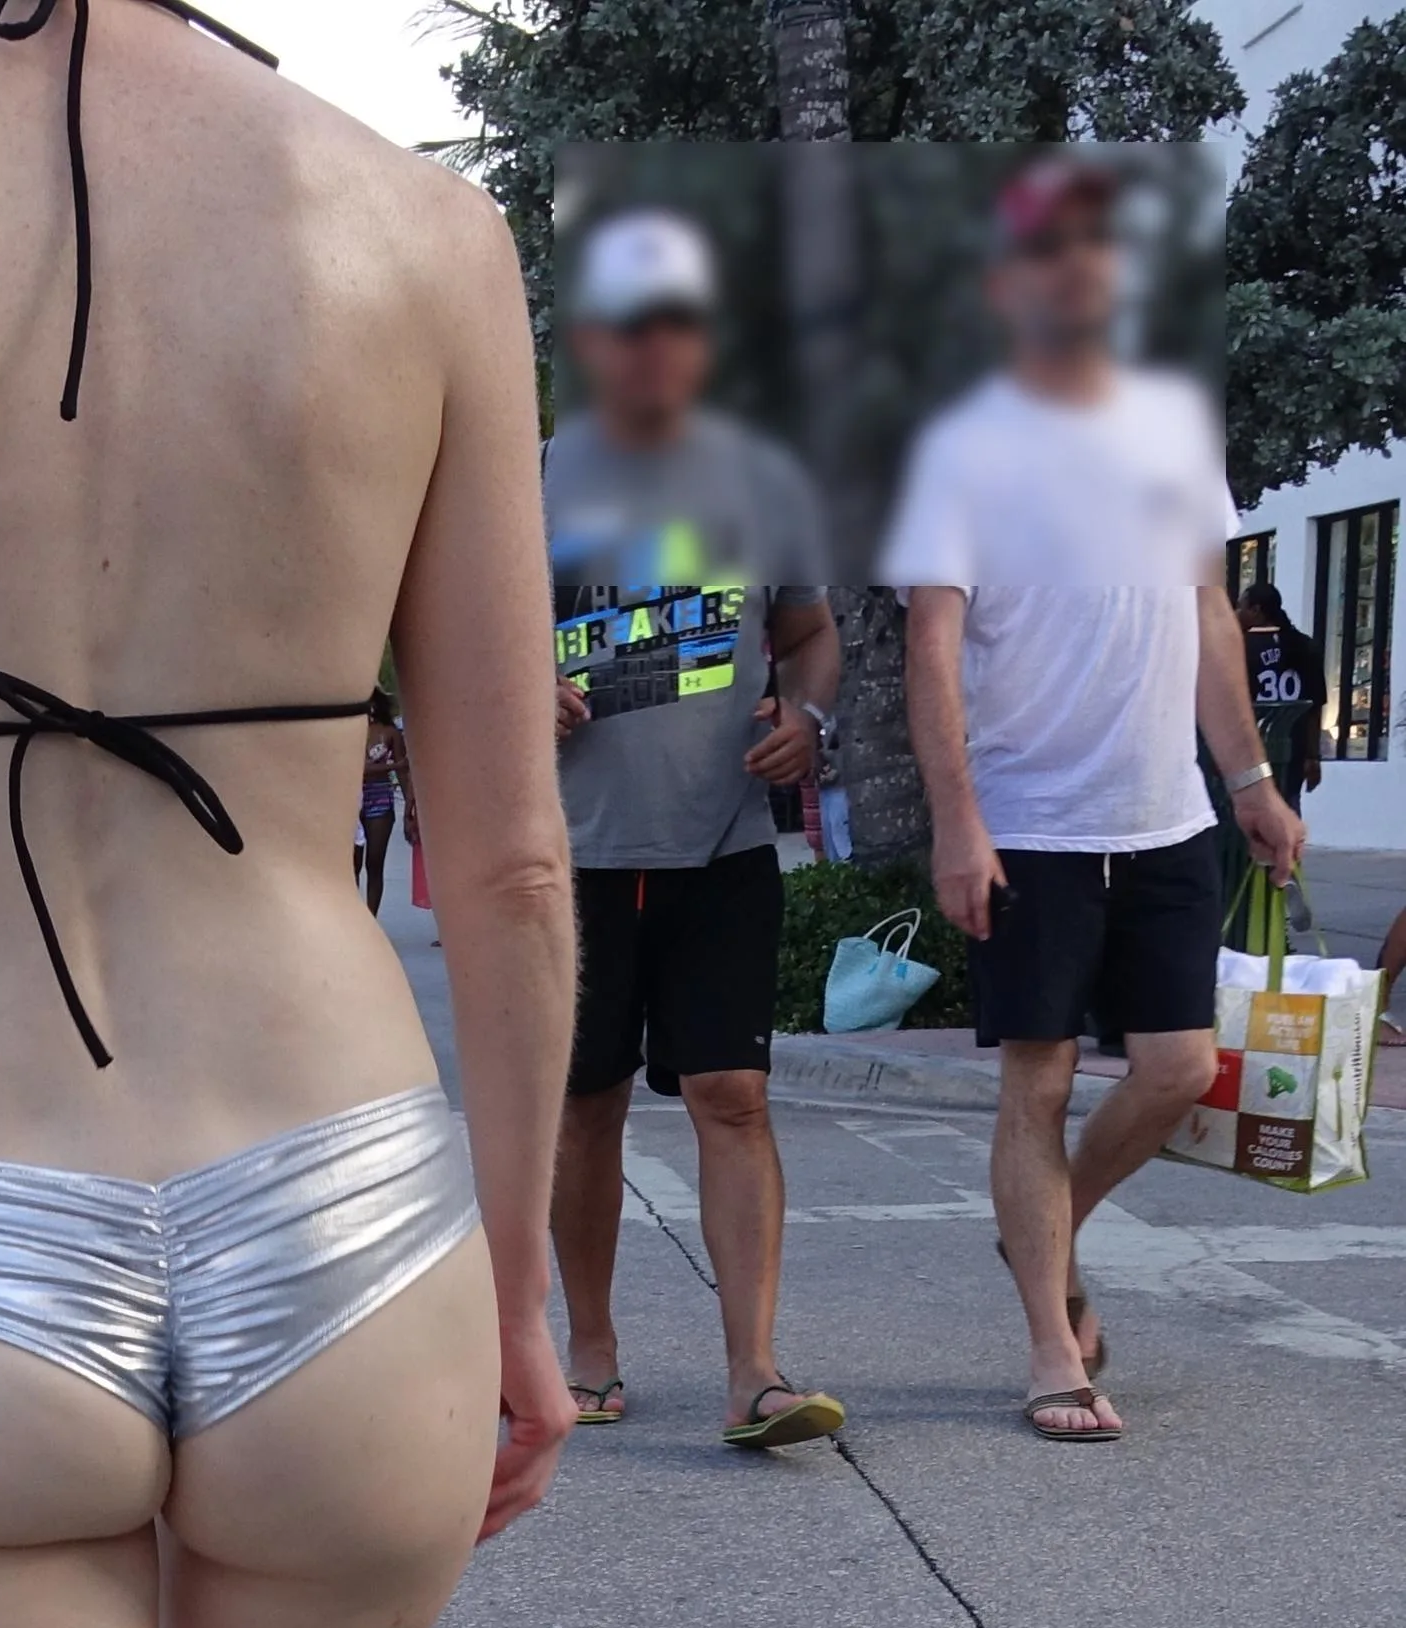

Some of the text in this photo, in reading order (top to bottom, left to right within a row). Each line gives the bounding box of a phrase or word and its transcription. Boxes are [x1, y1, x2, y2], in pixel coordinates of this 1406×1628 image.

[560, 587, 744, 661] BREAKERS
[1256, 669, 1302, 701] 30
[1258, 1124, 1296, 1138] MAKE
[1257, 1134, 1292, 1150] YOUR
[1246, 1144, 1304, 1161] CALORIES
[1252, 1156, 1296, 1172] COUNT
